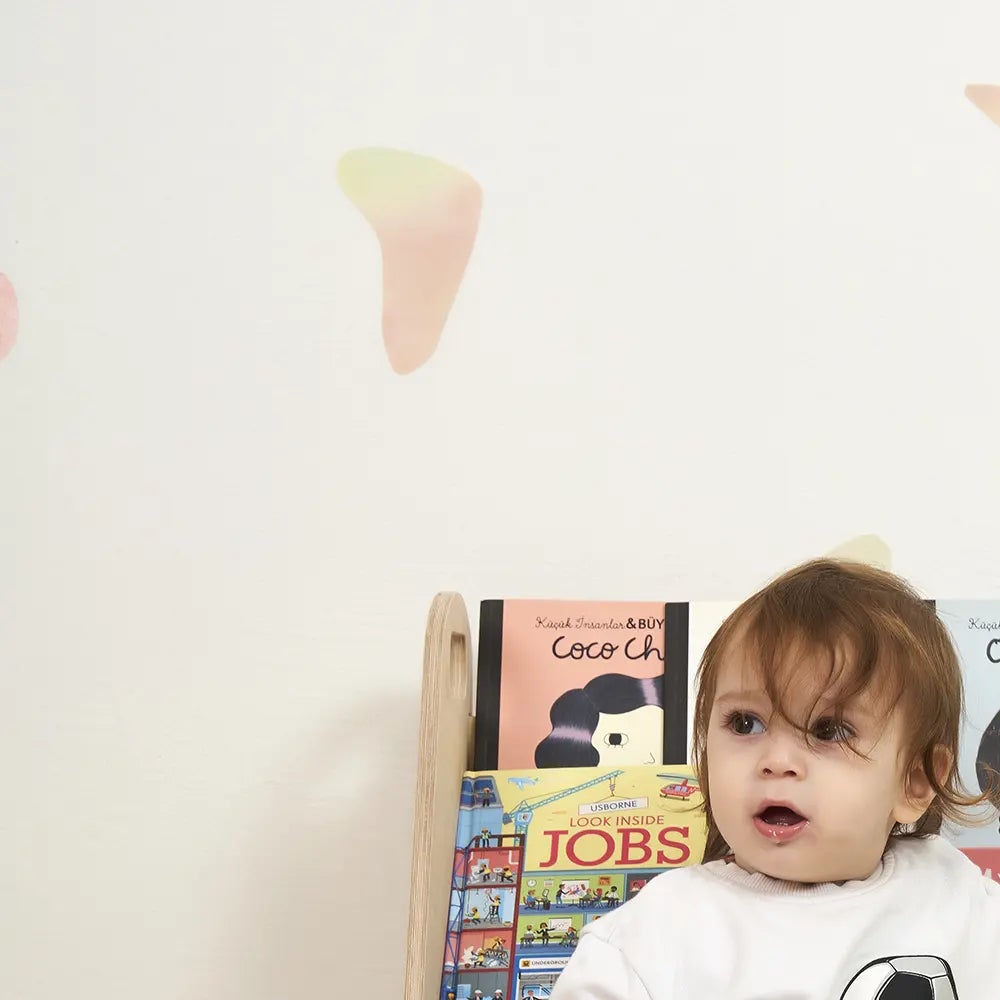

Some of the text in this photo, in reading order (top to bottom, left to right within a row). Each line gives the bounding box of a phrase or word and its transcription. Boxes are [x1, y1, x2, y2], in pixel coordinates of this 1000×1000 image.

[552, 635, 619, 660] Coco
[590, 800, 637, 812] USBORNE
[569, 815, 664, 828] LOOK INSIDE
[539, 826, 690, 868] JOBS
